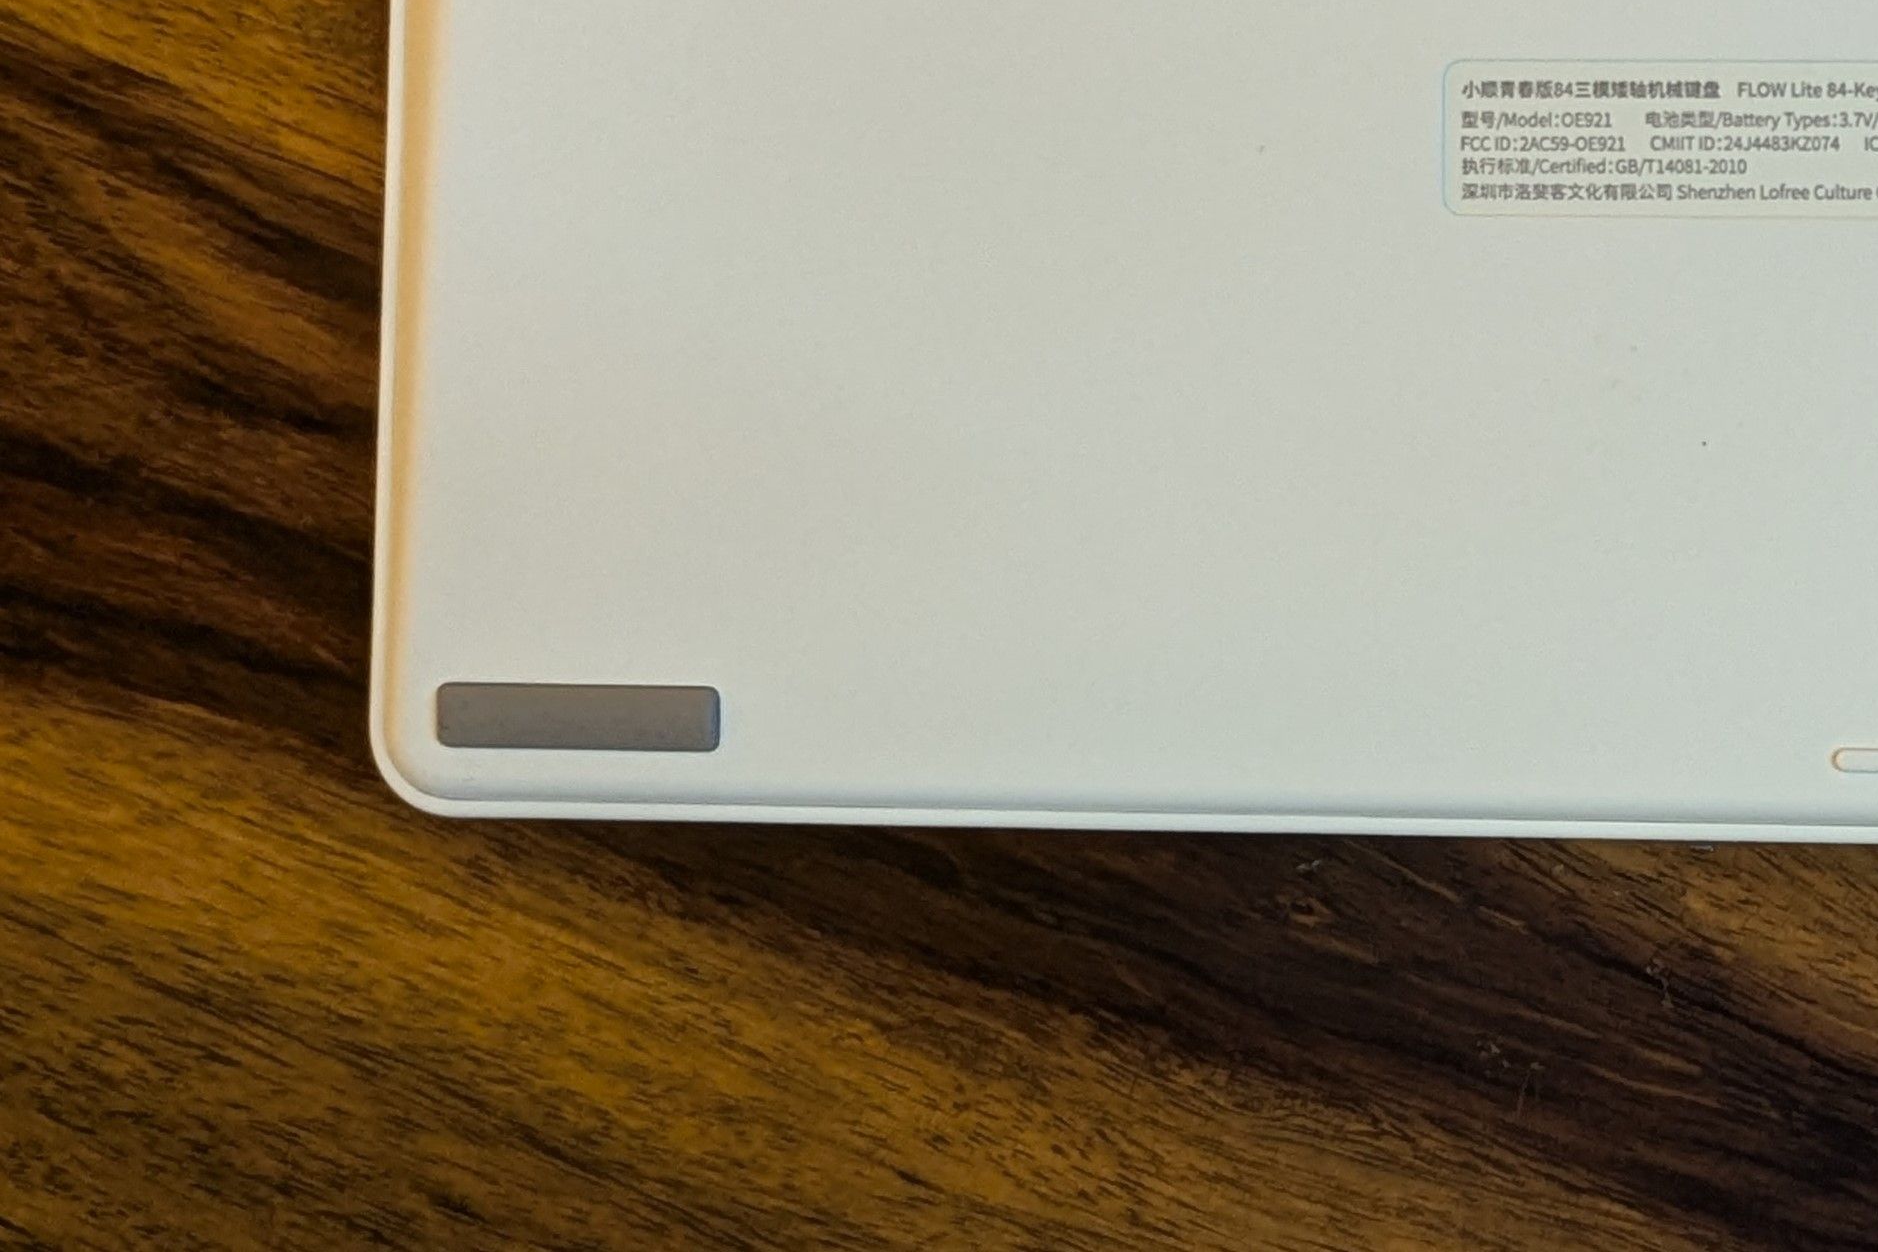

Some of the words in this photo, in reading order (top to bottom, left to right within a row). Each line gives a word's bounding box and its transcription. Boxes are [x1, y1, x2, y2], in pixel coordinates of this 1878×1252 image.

[1737, 81, 1787, 99] FLOW
[1790, 81, 1824, 99] Lite
[1460, 136, 1491, 152] FCC
[1650, 136, 1695, 152] CMIIT
[1678, 183, 1756, 200] Shenzhen
[1760, 183, 1811, 200] Lofree
[1814, 183, 1873, 201] Culture
